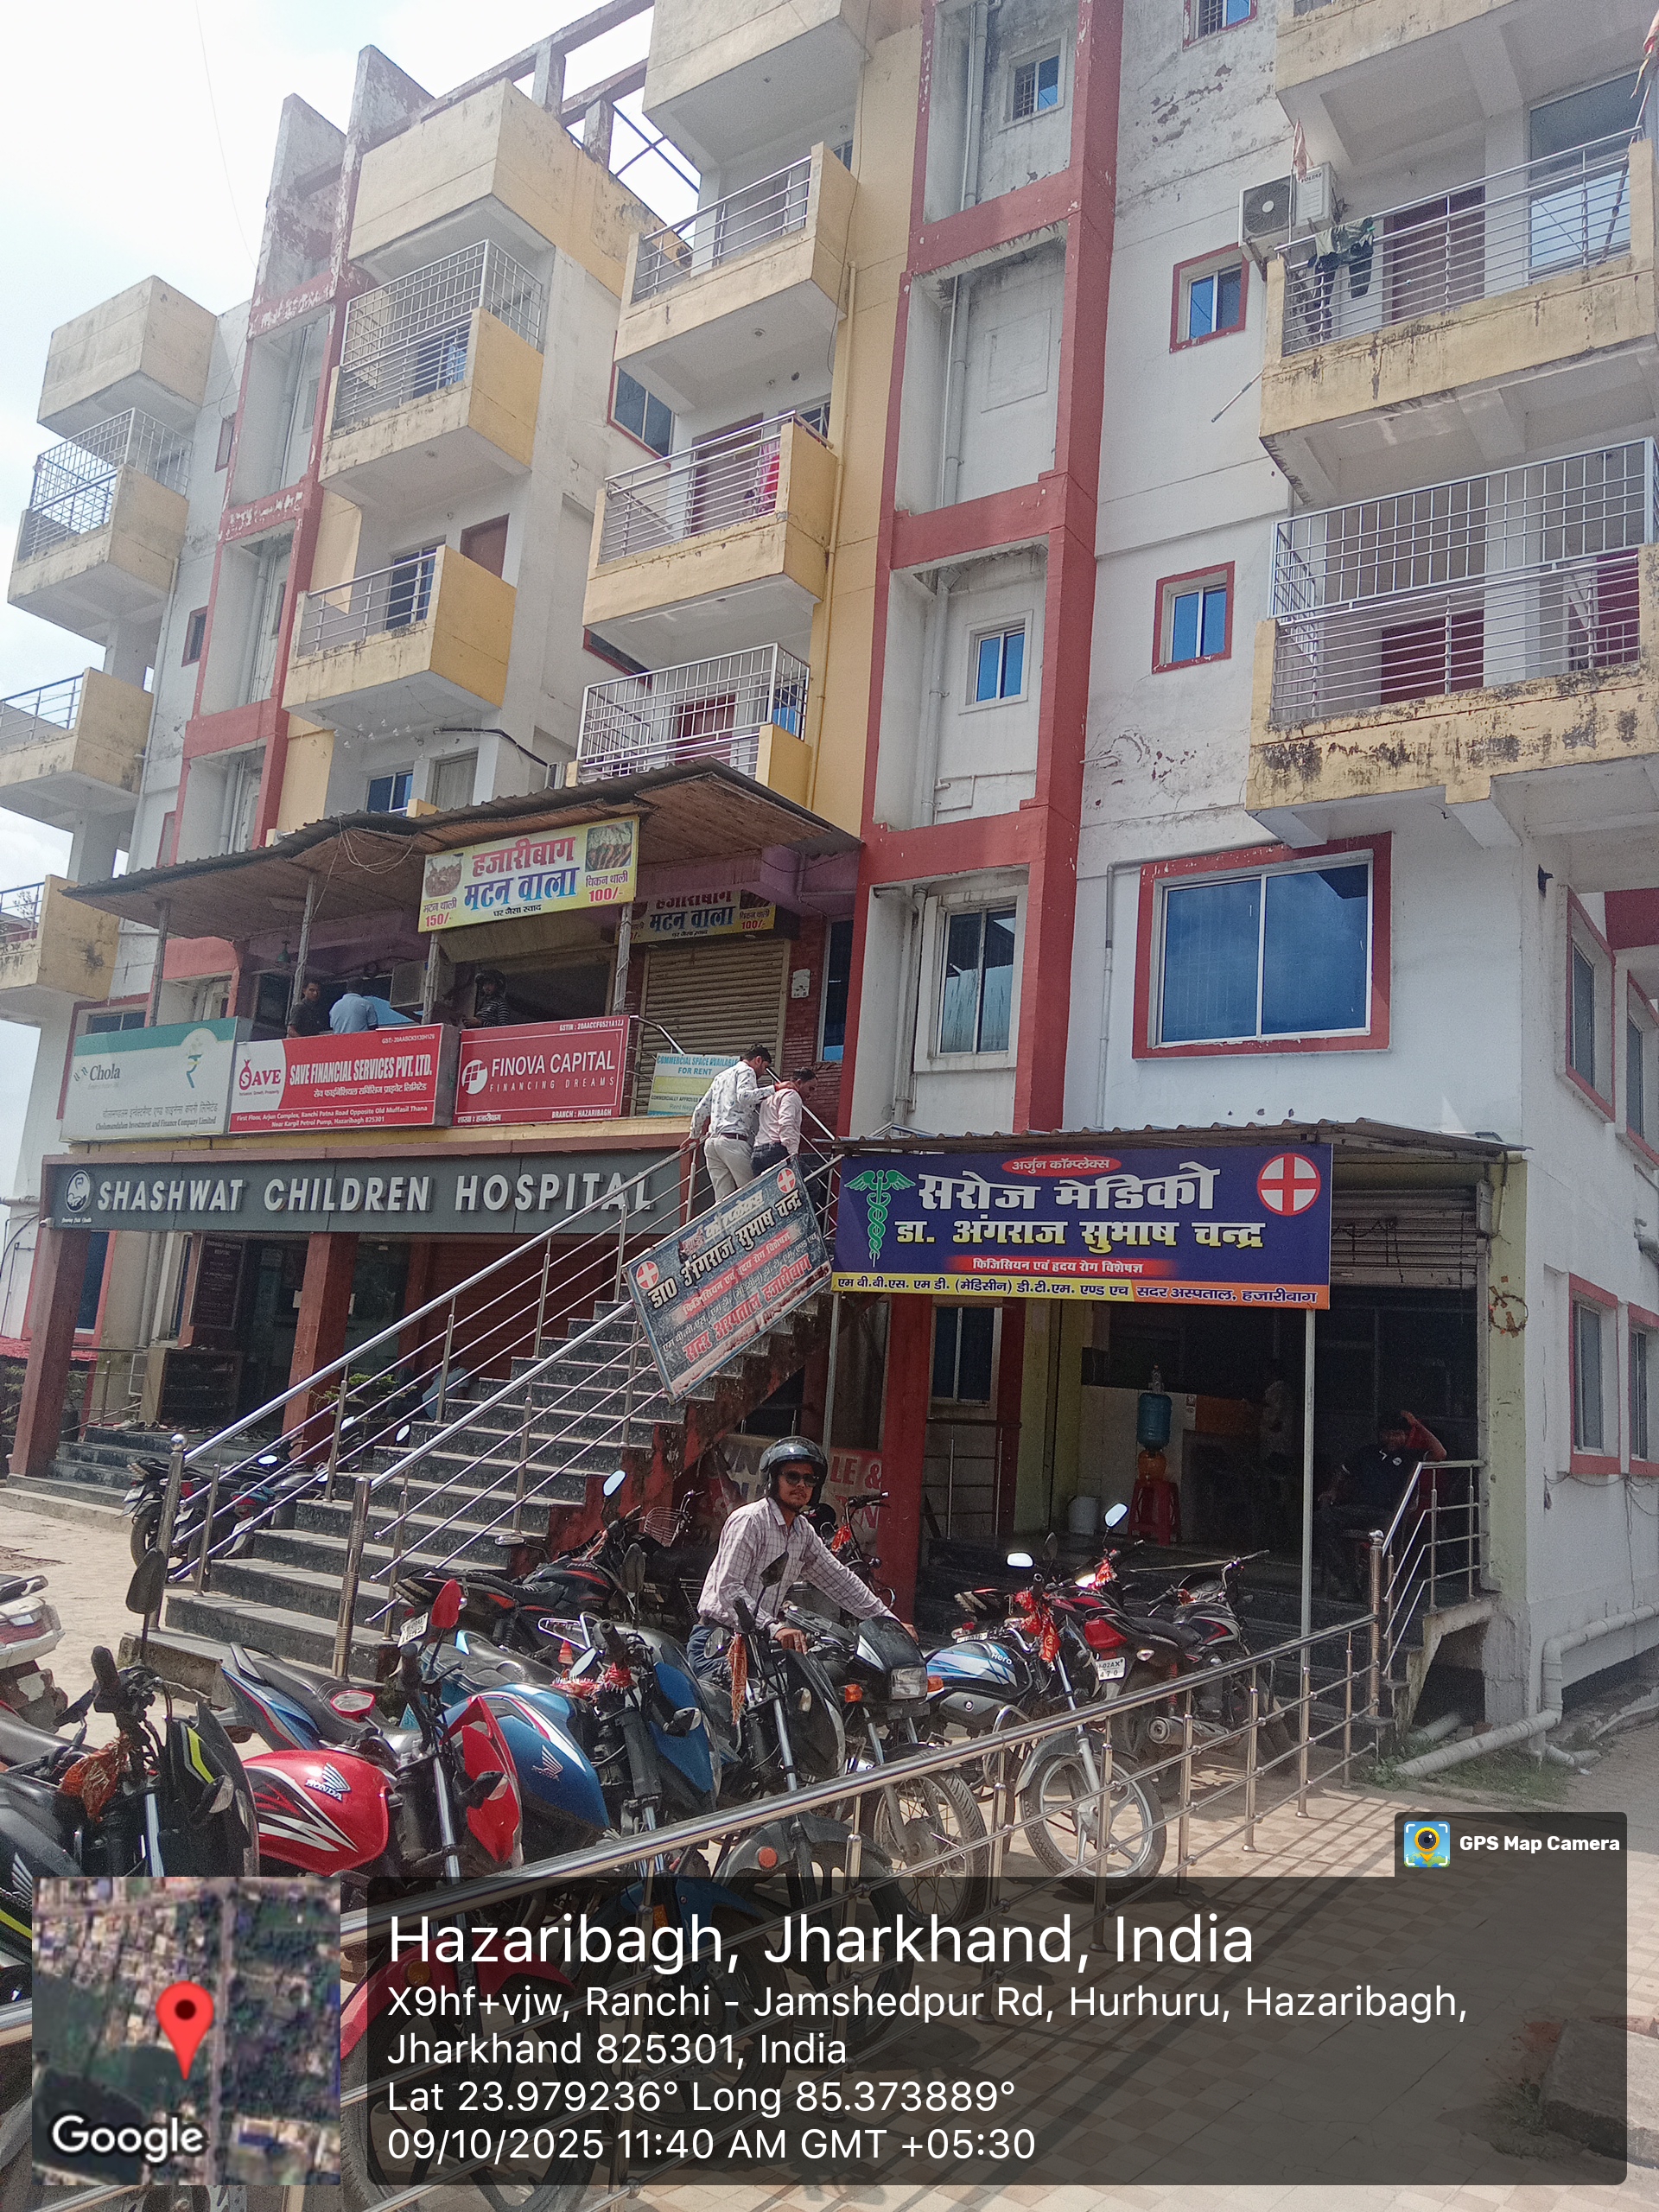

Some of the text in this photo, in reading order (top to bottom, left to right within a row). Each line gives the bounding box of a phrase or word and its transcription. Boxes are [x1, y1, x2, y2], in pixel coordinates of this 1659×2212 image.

[472, 836, 576, 877] हजारीबाग
[586, 870, 628, 887] चिकन थाली
[464, 867, 580, 911] मटन वाला
[588, 886, 623, 903] 100/-
[425, 912, 452, 927] 150/-
[649, 906, 735, 931] मटन वाला
[289, 1053, 432, 1085] SAVE FINANCIAL SERVICES PVT. LTD.
[492, 1050, 615, 1077] FINOVA CAPITAL
[657, 1055, 690, 1065] COMMERCIAL
[692, 1057, 709, 1066] SPACE
[90, 1064, 120, 1081] Chola
[239, 1070, 282, 1090] SAVE
[489, 1077, 614, 1092] FINANCING DREAMS
[334, 1116, 364, 1125] Hazaribagh
[350, 1108, 374, 1116] Opposite
[578, 1109, 612, 1117] HAZARIBAGH
[1012, 1157, 1110, 1174] अर्जुन कॉम्प्लेक्स
[98, 1172, 654, 1211] SHASHWAT CHILDREN HOSPITAL
[918, 1161, 1221, 1210] सरोज मेडिको
[734, 1208, 775, 1250] सुभाष
[775, 1190, 803, 1217] चन्द्र
[894, 1214, 1267, 1254] डा. अंगराज सुभाष चन्द्र
[973, 1258, 1029, 1270] फिजिसियन
[1033, 1260, 1050, 1271] एवं
[1079, 1260, 1098, 1272] रोग
[1102, 1261, 1144, 1274] विशेषज्ञ
[837, 1278, 854, 1287] एम
[913, 1280, 931, 1289] एम
[933, 1277, 950, 1290] डी.
[955, 1278, 1013, 1294] (मेडिसीन)
[1016, 1280, 1075, 1294] डी.टी.एम.
[1080, 1285, 1105, 1295] एण्ड
[1109, 1286, 1128, 1295] एच
[1136, 1287, 1167, 1297] सदर
[1170, 1287, 1236, 1301] अस्पताल,
[1242, 1288, 1318, 1303] हजारीबाग
[683, 1332, 712, 1363] सदर
[713, 1293, 762, 1341] अस्पताल
[762, 1254, 813, 1303] हजारीबाग
[991, 1652, 1012, 1665] Hero
[304, 1778, 343, 1802] HONDA
